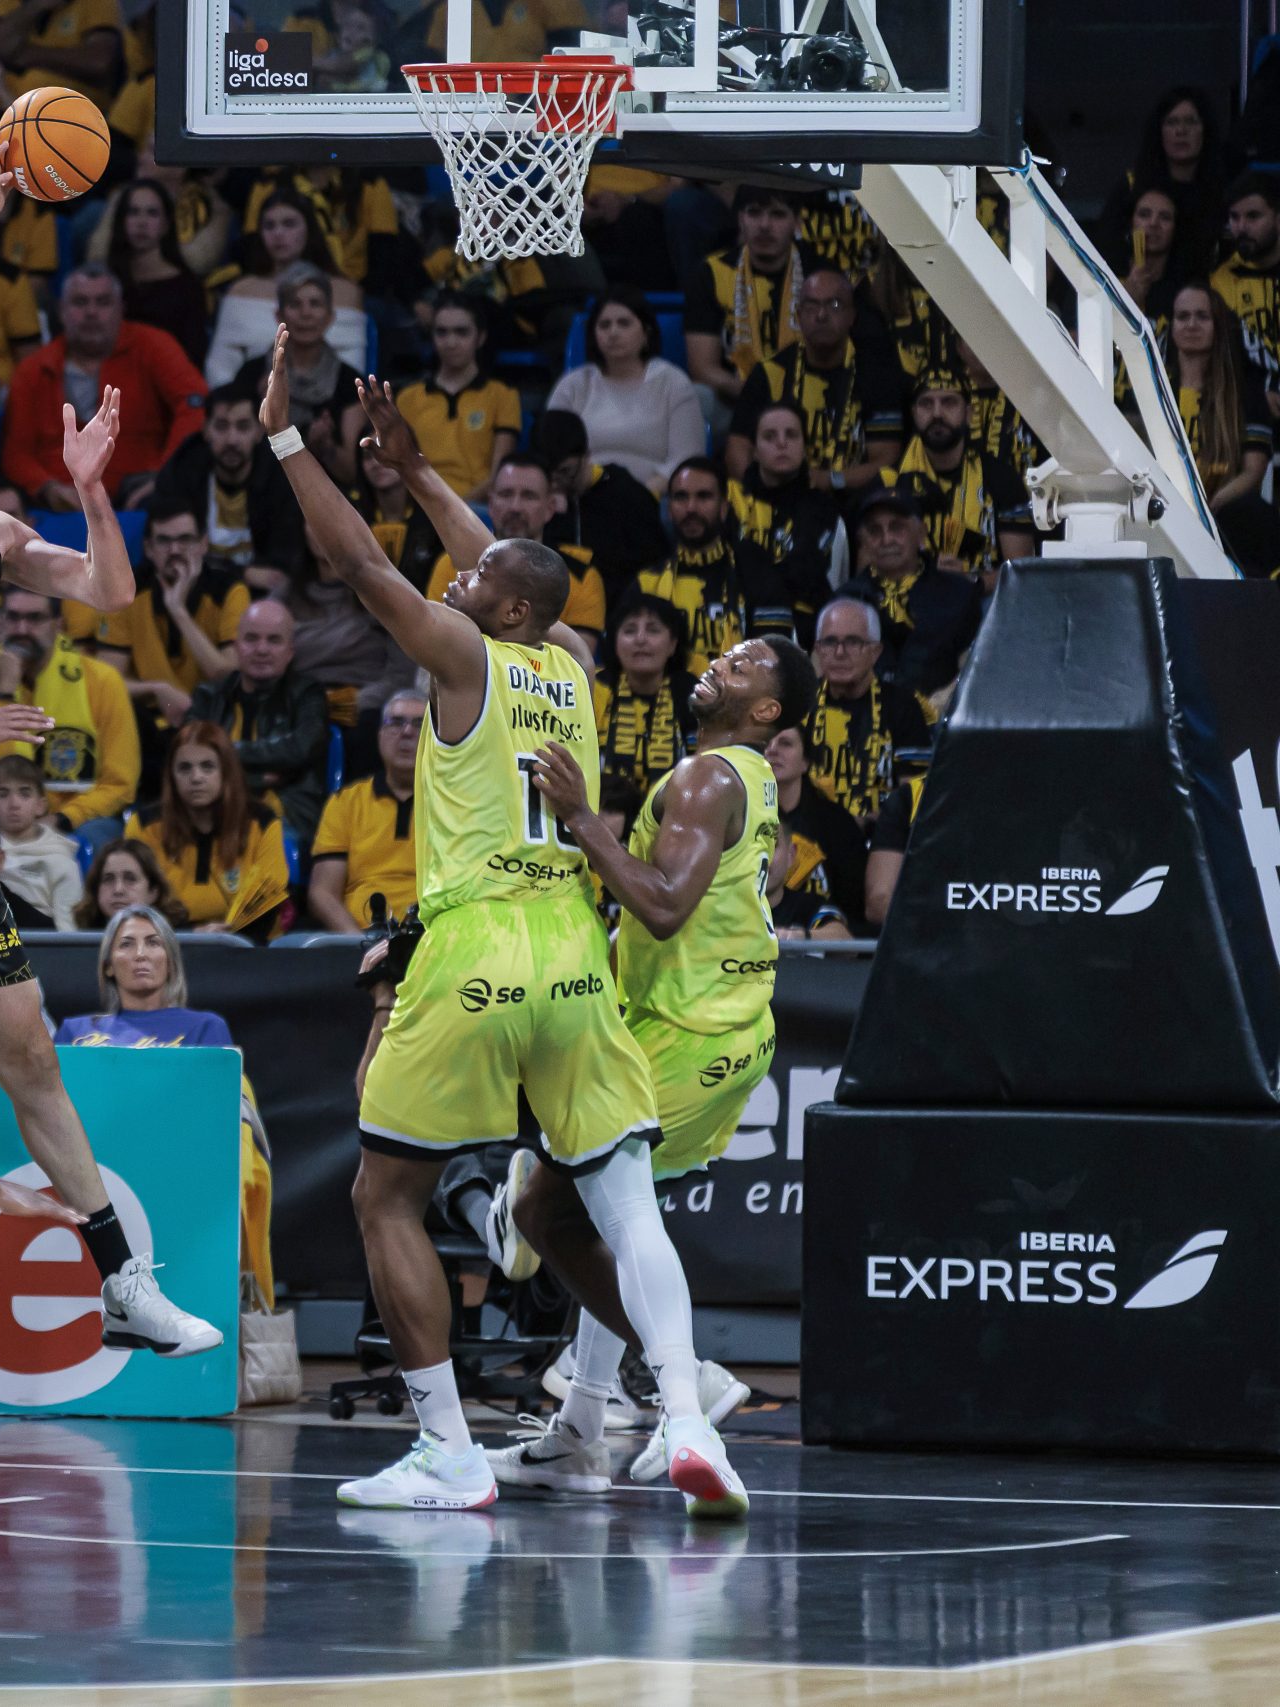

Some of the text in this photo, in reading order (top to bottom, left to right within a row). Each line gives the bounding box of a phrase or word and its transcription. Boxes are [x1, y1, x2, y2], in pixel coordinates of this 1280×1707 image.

[228, 49, 265, 71] liga
[228, 68, 308, 87] endesa
[507, 664, 576, 709] DIANE
[1041, 866, 1102, 882] IBERIA
[946, 882, 1102, 913] EXPRESS
[1020, 1231, 1116, 1253] IBERIA
[867, 1255, 1118, 1306] EXPRESS
